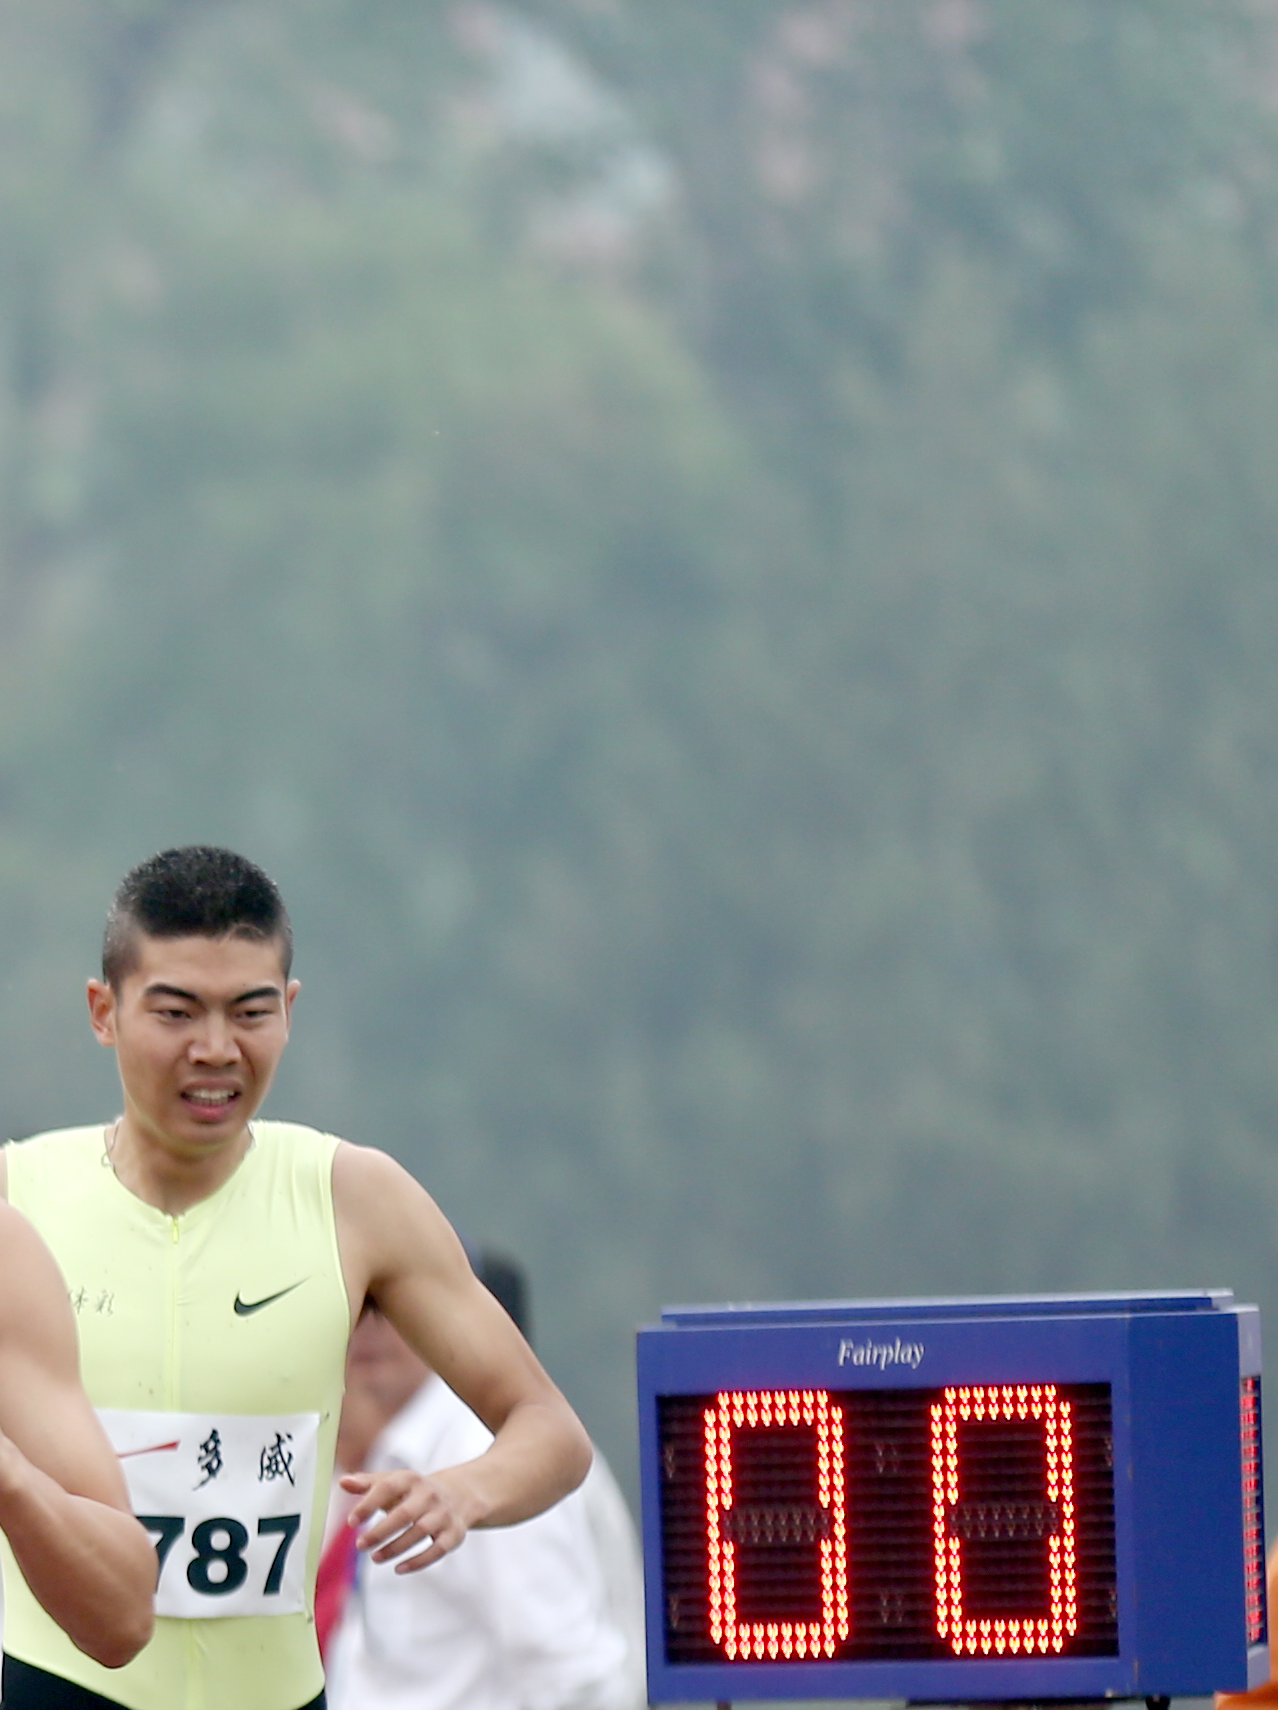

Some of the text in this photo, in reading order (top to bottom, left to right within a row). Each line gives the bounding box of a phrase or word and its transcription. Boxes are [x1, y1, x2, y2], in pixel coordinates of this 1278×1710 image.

[838, 1336, 925, 1370] Fairplay
[194, 1428, 295, 1490] 多威
[134, 1514, 301, 1596] 787
[703, 1384, 1078, 1661] 00
